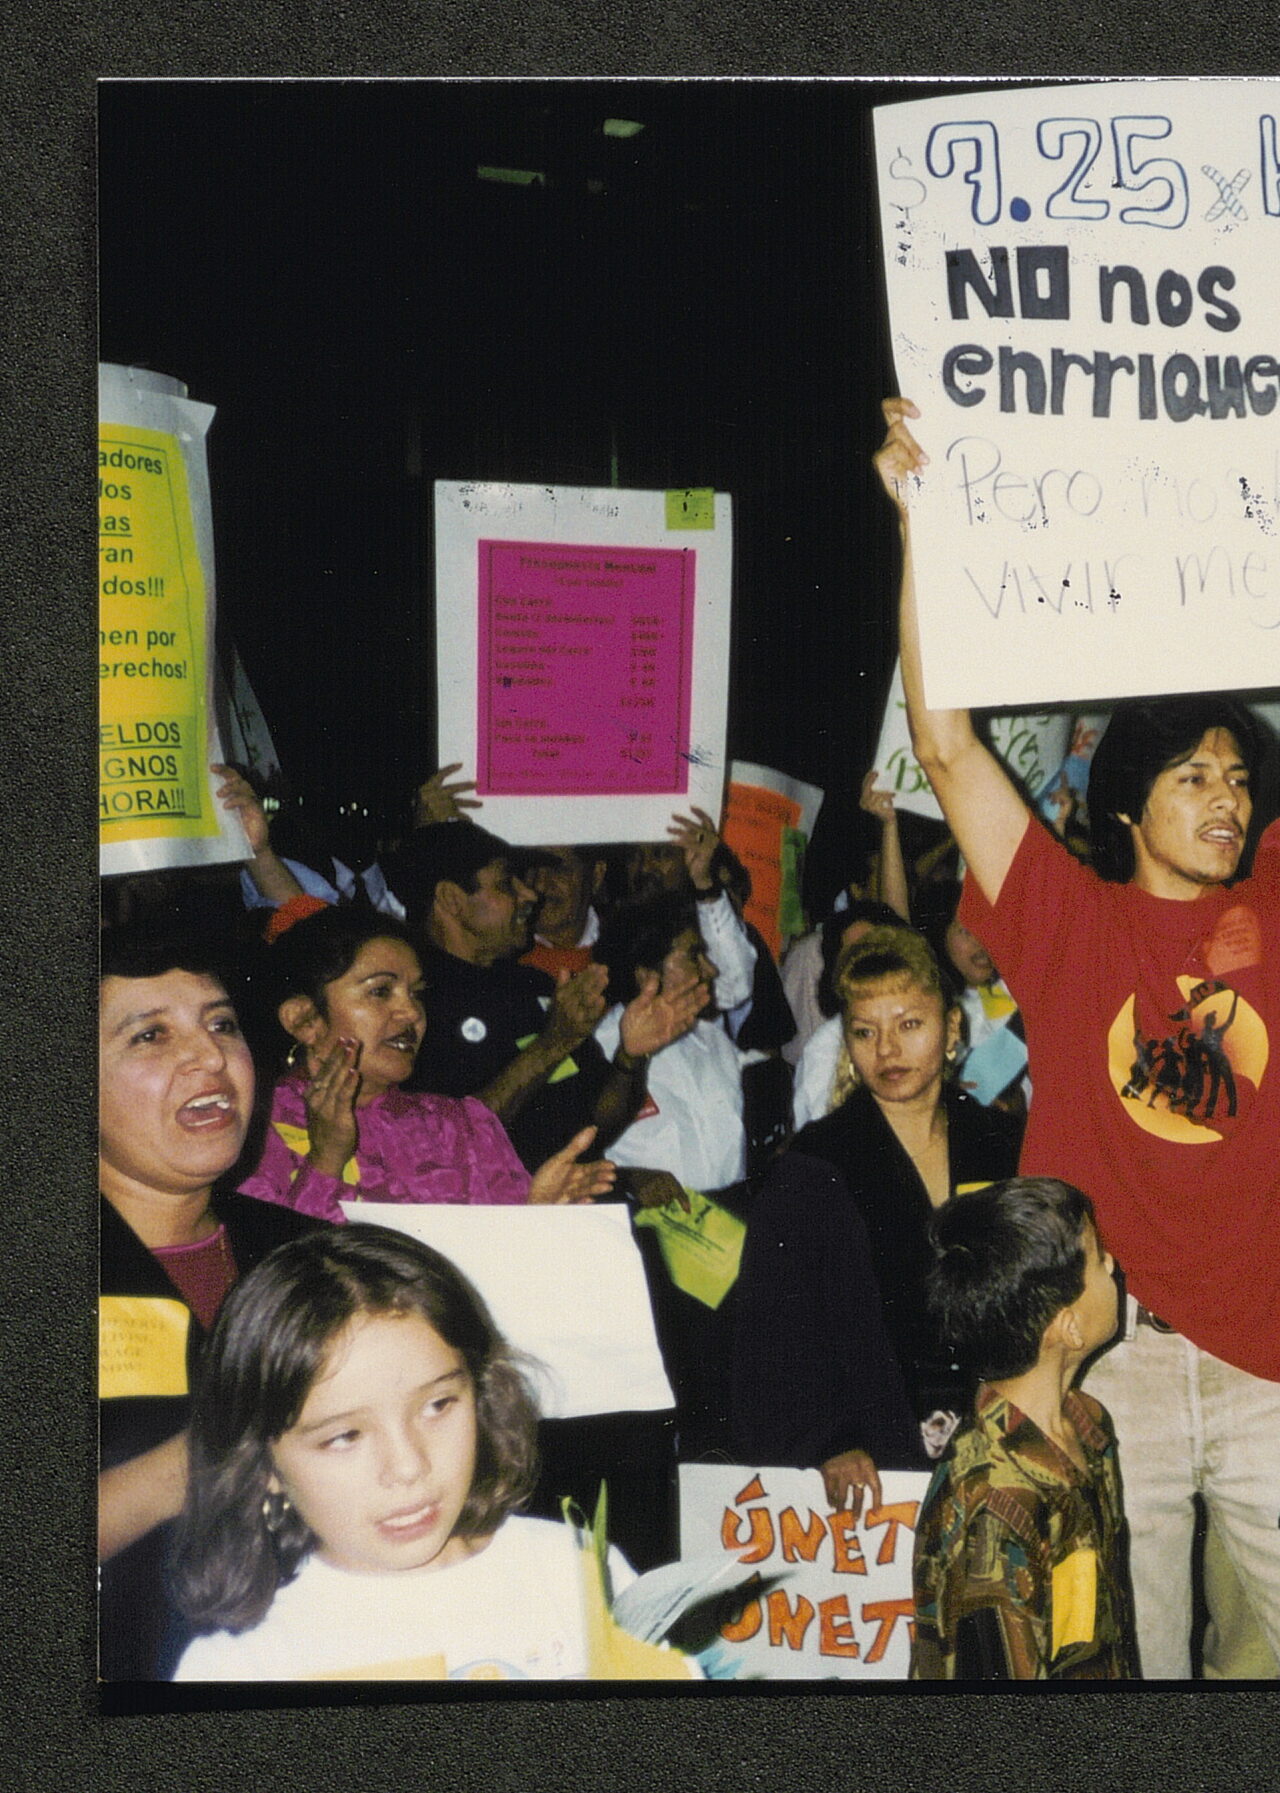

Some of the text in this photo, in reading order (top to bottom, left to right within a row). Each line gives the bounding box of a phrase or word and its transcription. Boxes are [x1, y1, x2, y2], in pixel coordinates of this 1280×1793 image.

[945, 246, 1241, 332] NO nos
[946, 436, 1102, 525] Pero
[963, 551, 1142, 618] vivir
[147, 632, 176, 651] por
